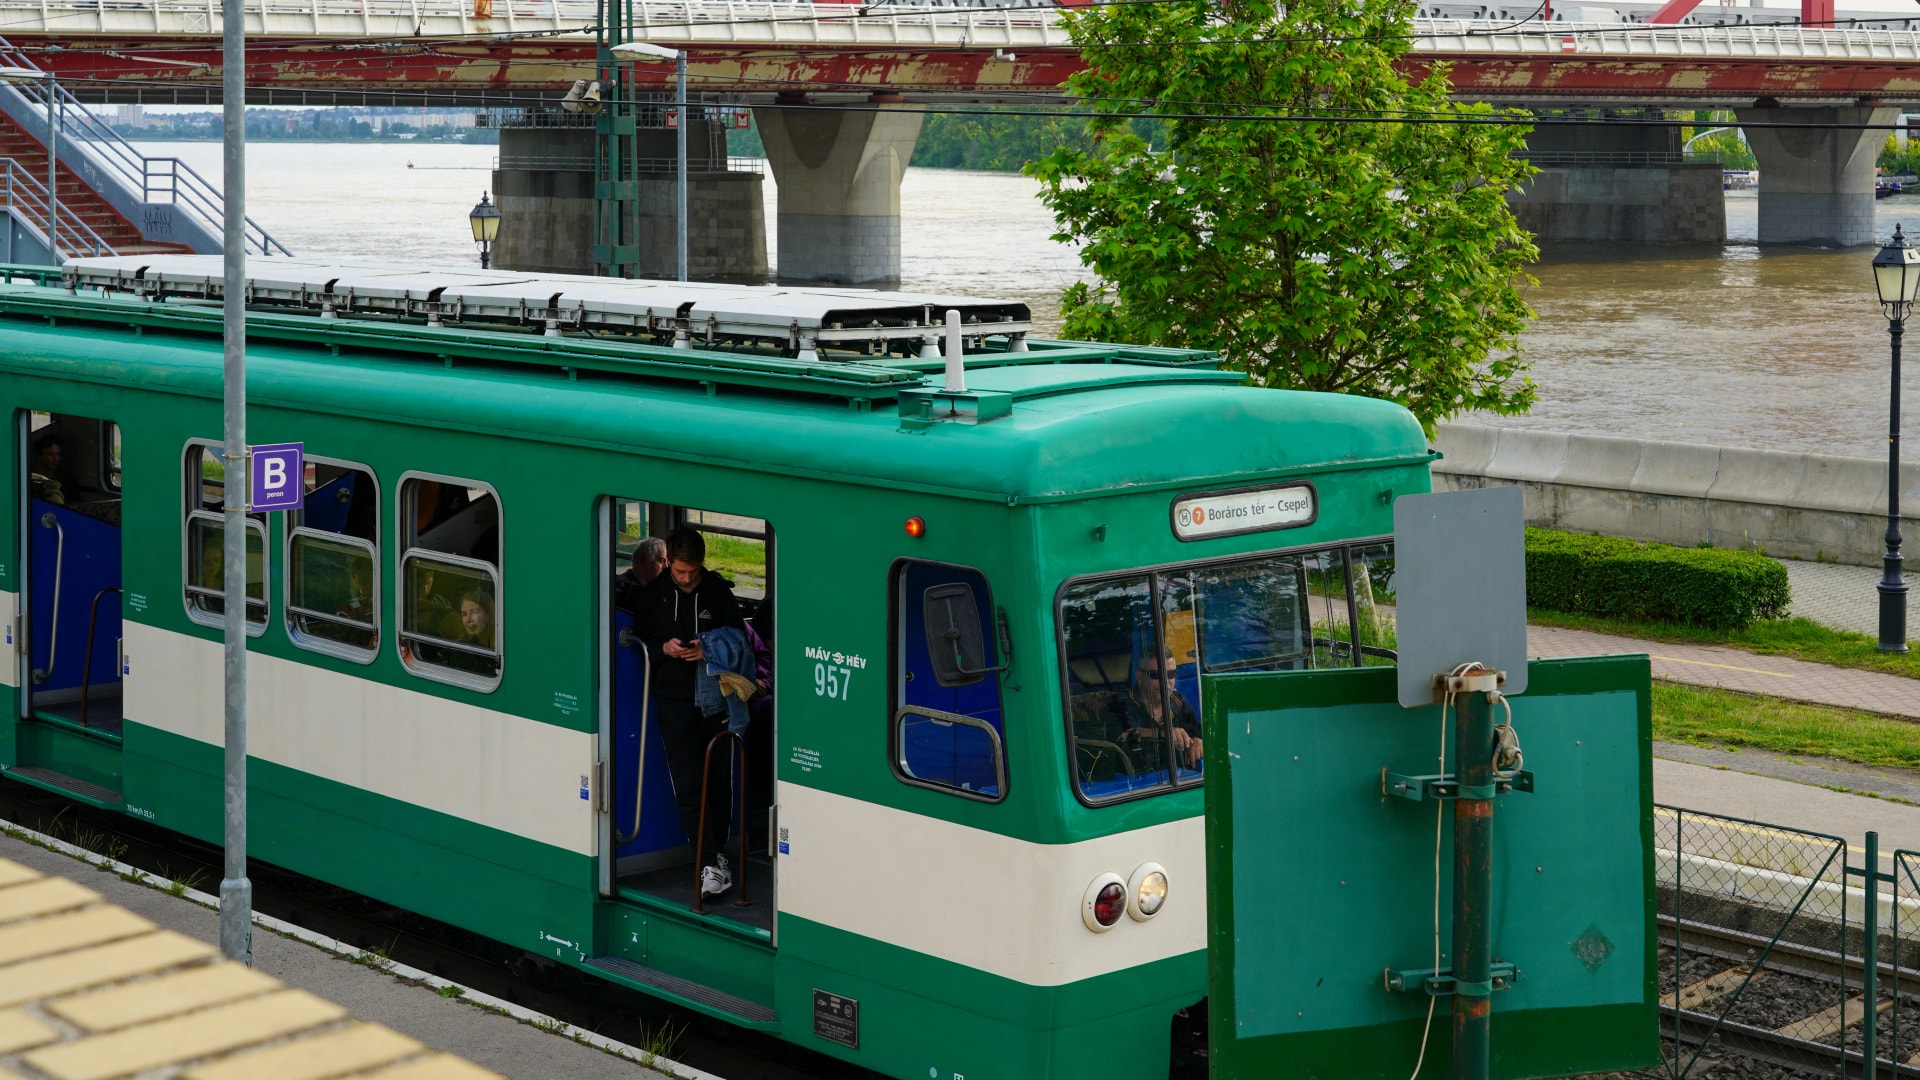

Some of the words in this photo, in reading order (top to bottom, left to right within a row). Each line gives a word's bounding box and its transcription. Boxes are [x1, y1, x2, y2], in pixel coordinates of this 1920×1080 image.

[264, 457, 287, 490] B
[266, 491, 284, 499] peron
[1208, 505, 1248, 521] Boráros
[1251, 501, 1266, 516] tér
[1277, 496, 1309, 514] Csepel
[805, 646, 831, 661] MÁV
[846, 654, 867, 669] HÉV
[814, 662, 851, 701] 957
[540, 930, 544, 940] 3
[575, 942, 580, 951] 2
[557, 947, 561, 957] R
